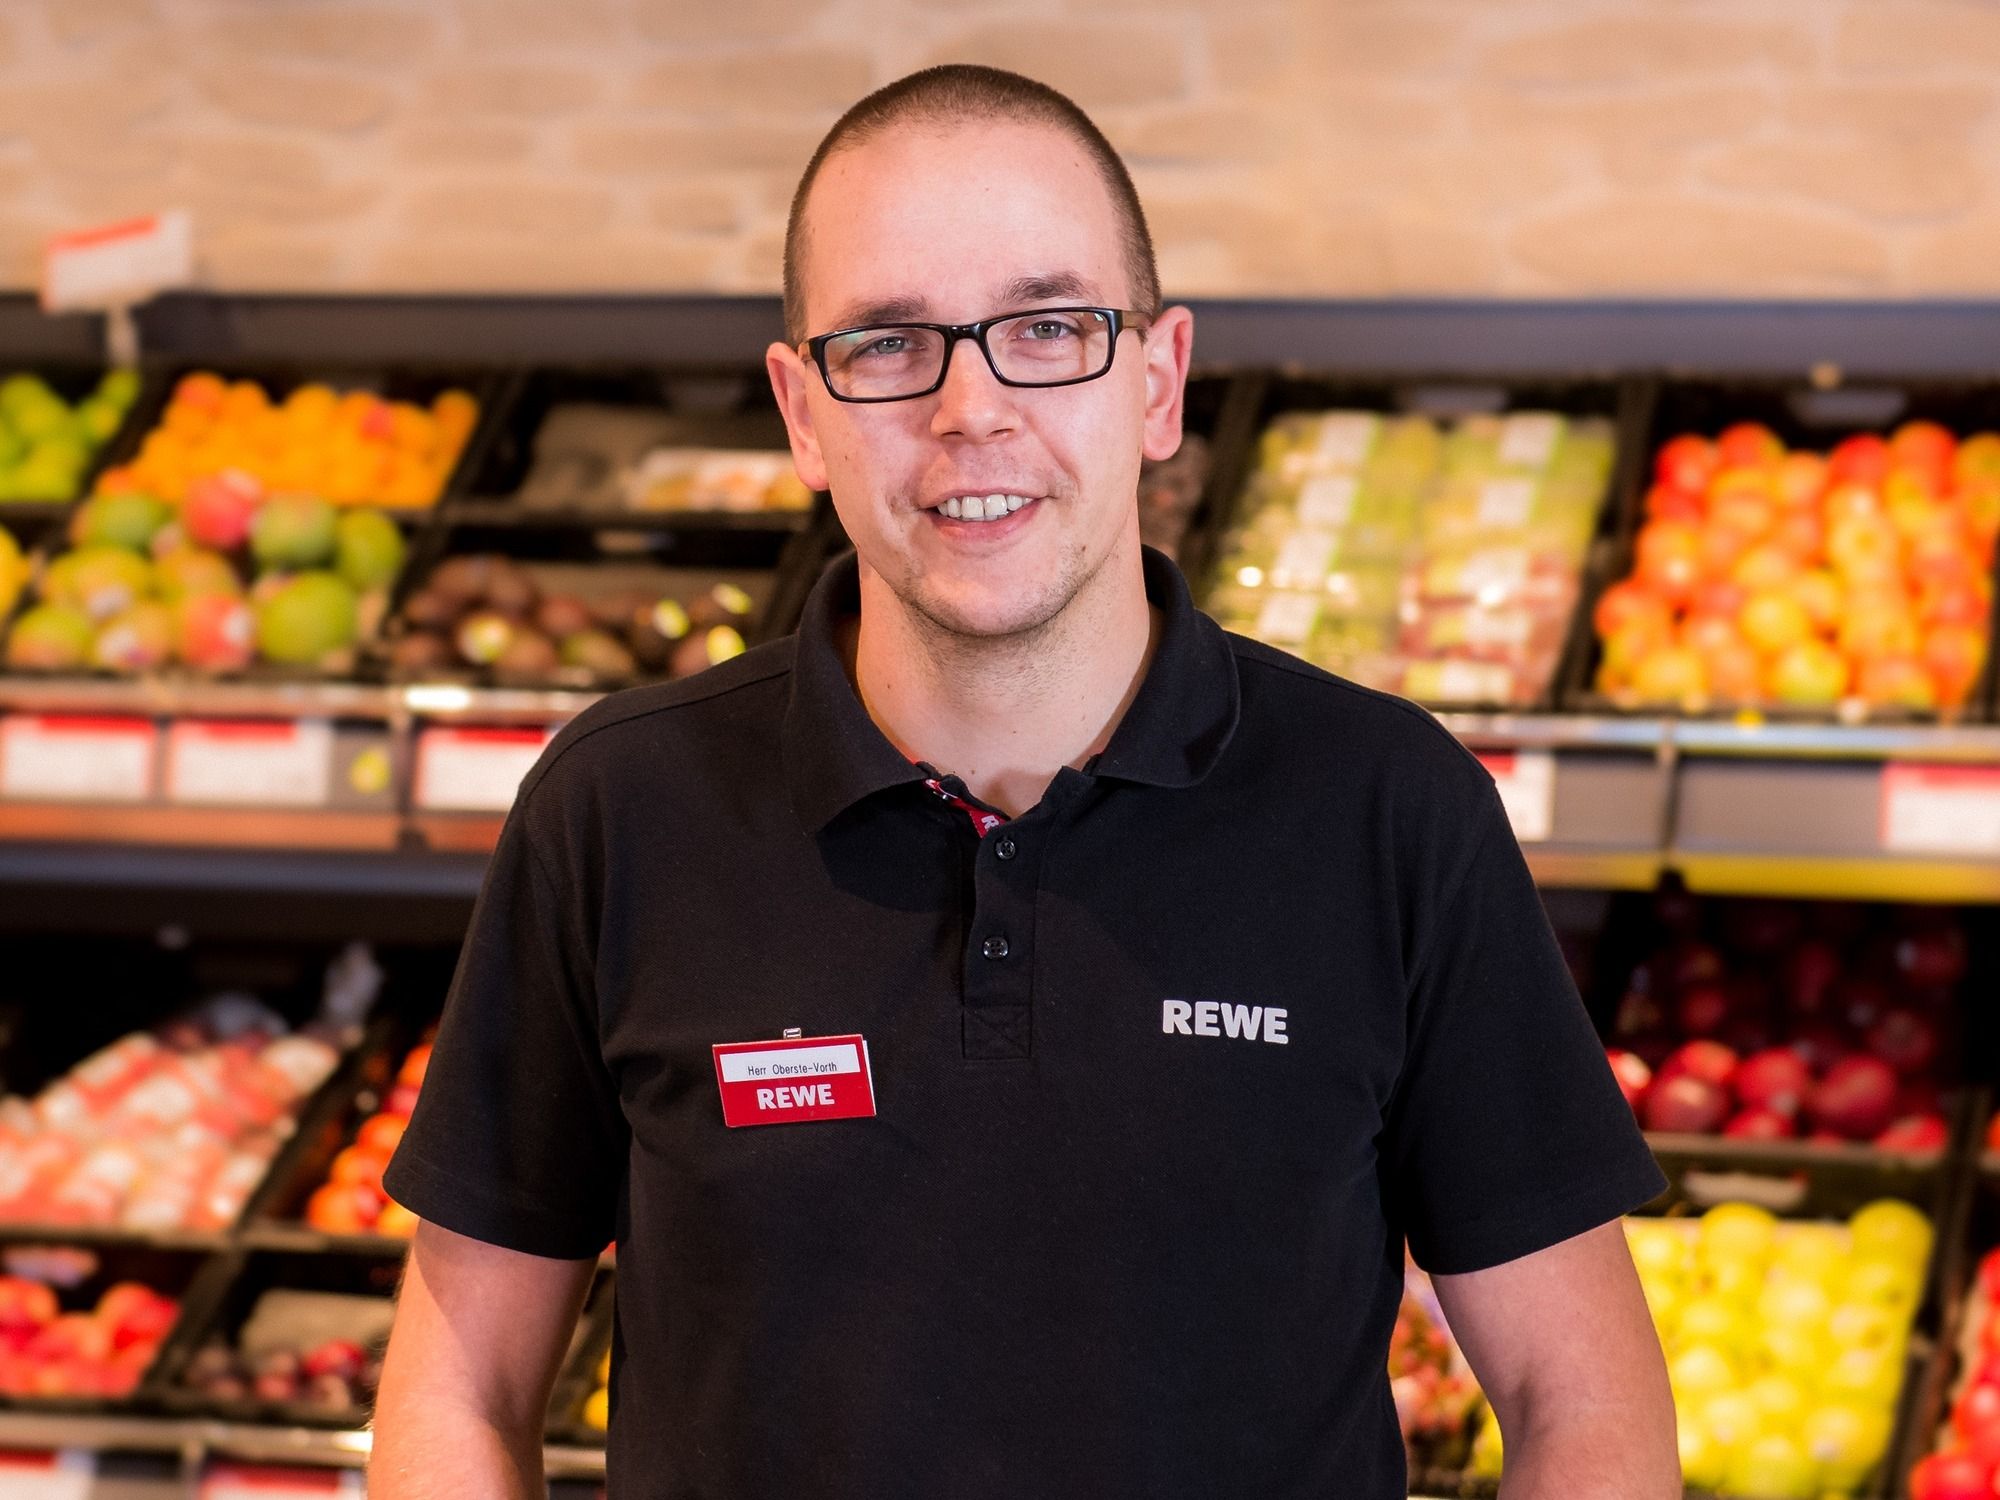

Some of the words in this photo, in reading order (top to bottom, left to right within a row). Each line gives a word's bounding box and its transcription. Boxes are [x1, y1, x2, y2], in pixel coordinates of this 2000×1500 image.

[1162, 1000, 1289, 1045] REWE
[747, 1065, 767, 1076] Herr
[772, 1062, 838, 1075] Oberste-Vorth
[756, 1083, 835, 1110] REWE
